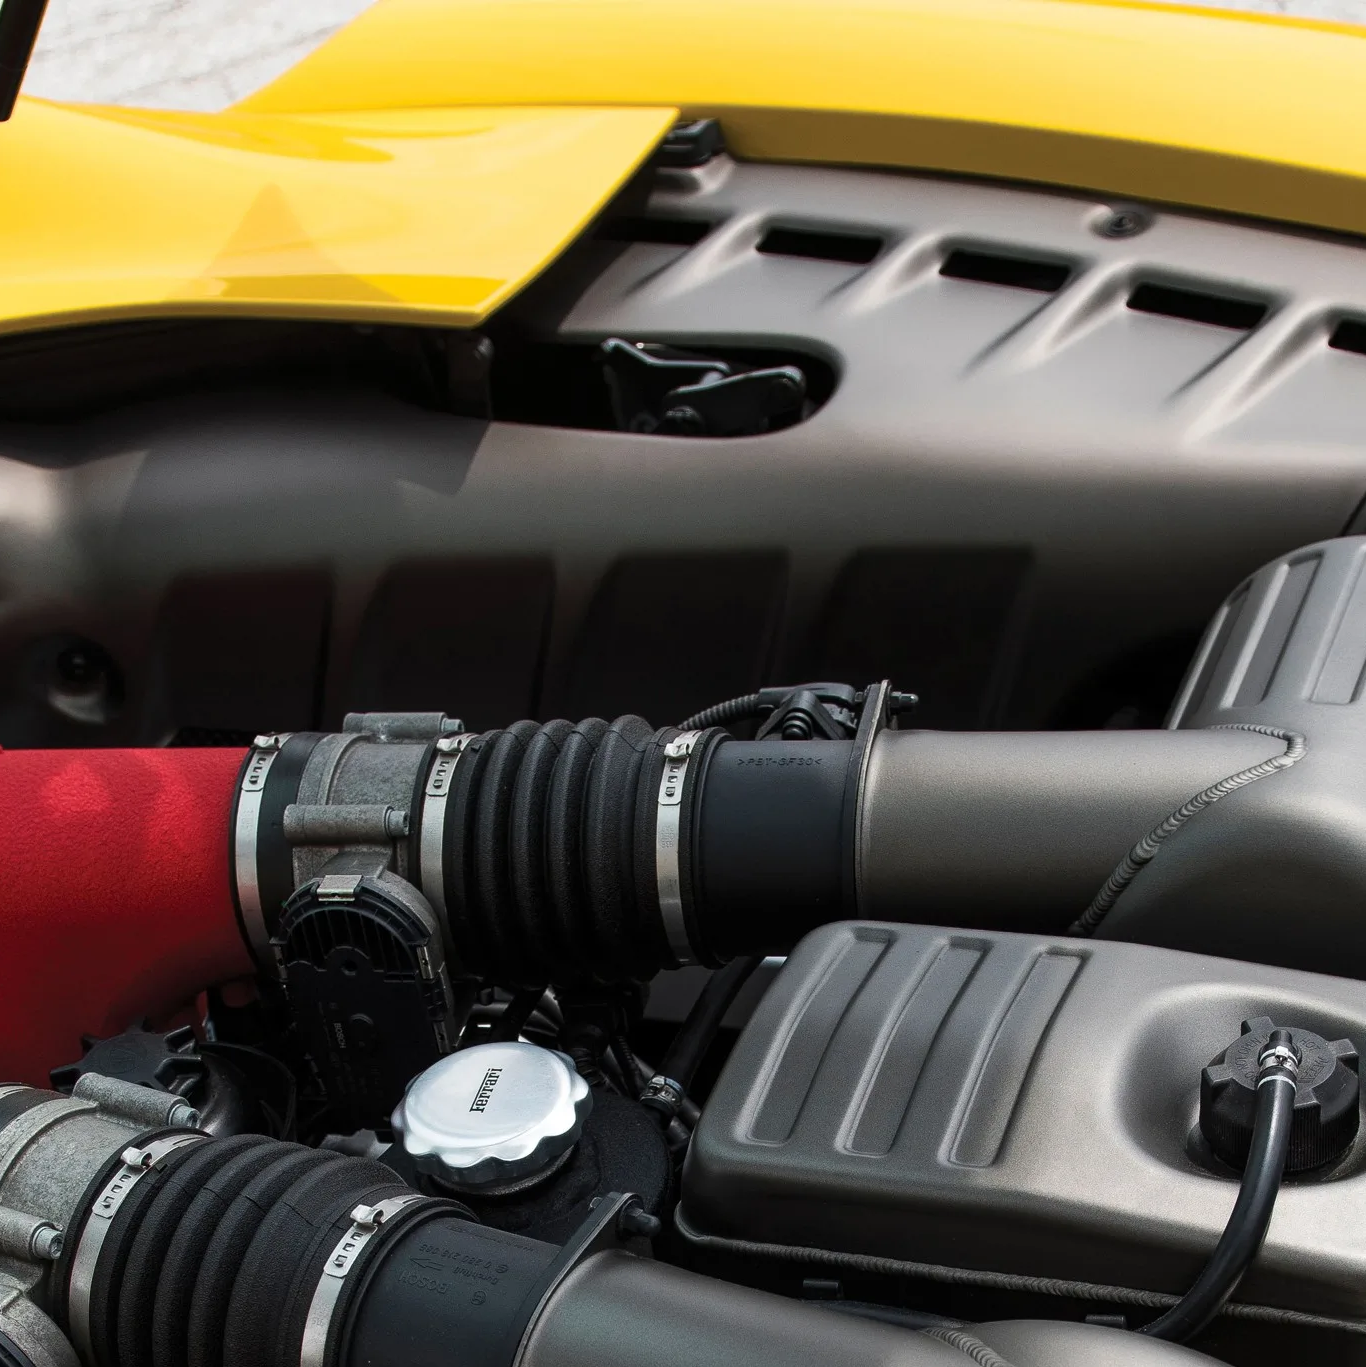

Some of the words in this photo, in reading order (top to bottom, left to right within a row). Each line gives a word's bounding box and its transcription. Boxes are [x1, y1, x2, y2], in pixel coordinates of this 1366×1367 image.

[333, 1022, 347, 1049] BOSCH
[1299, 1036, 1322, 1053] HOT
[469, 1068, 503, 1113] Ferrari
[398, 1270, 450, 1294] BOSCH
